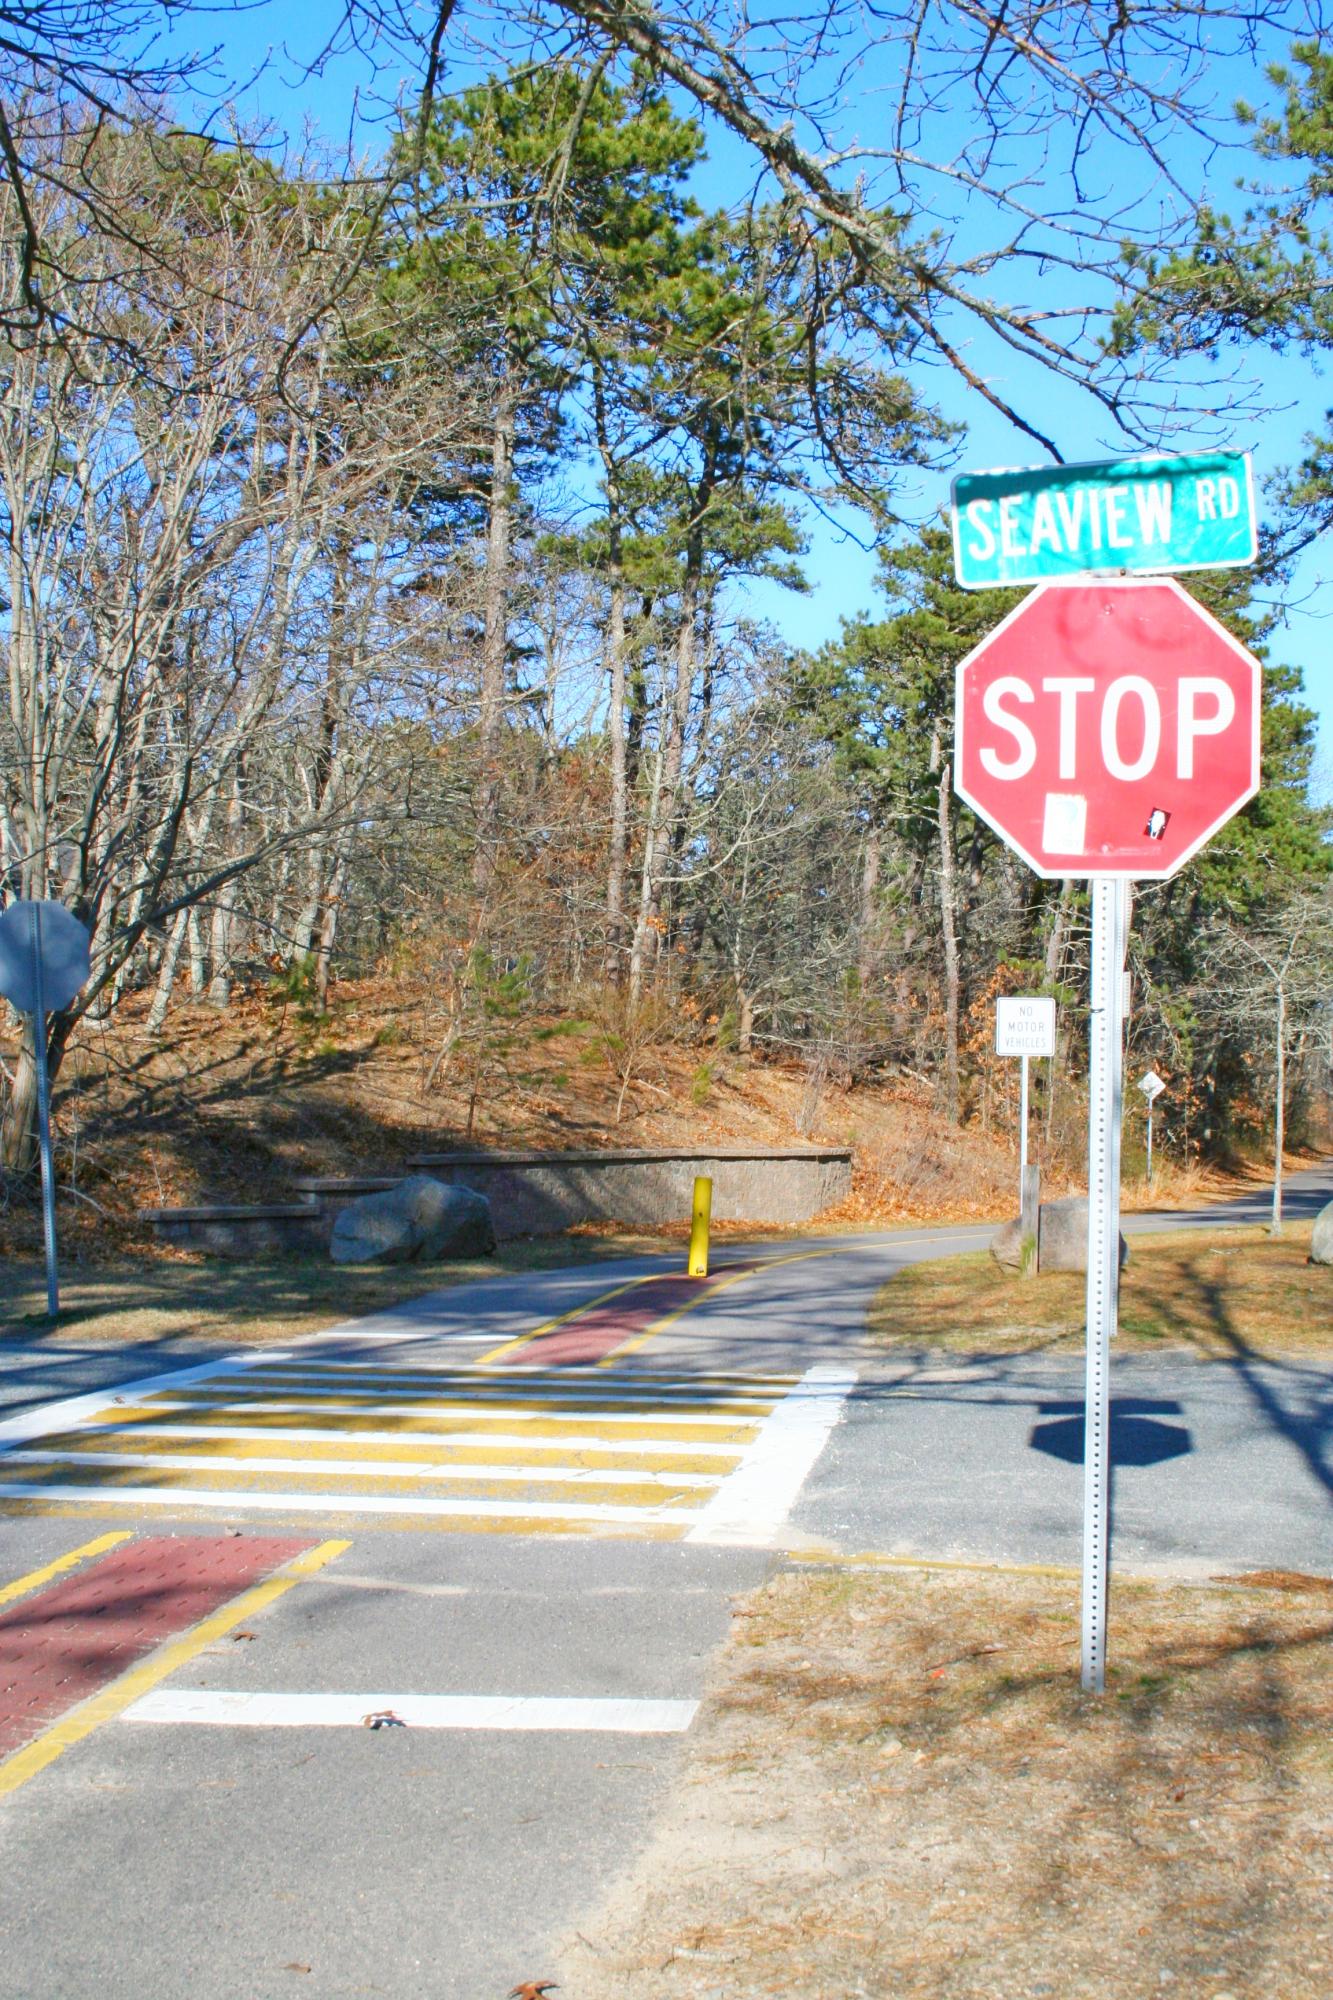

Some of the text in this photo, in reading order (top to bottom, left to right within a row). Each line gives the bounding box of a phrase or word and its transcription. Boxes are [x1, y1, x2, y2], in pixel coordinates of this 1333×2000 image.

[966, 477, 1239, 561] SEAVIEW RD
[979, 675, 1236, 782] STOP
[1019, 1006, 1033, 1017] NO
[1007, 1021, 1045, 1033] MOTOR
[1004, 1036, 1046, 1049] VEHICLES
